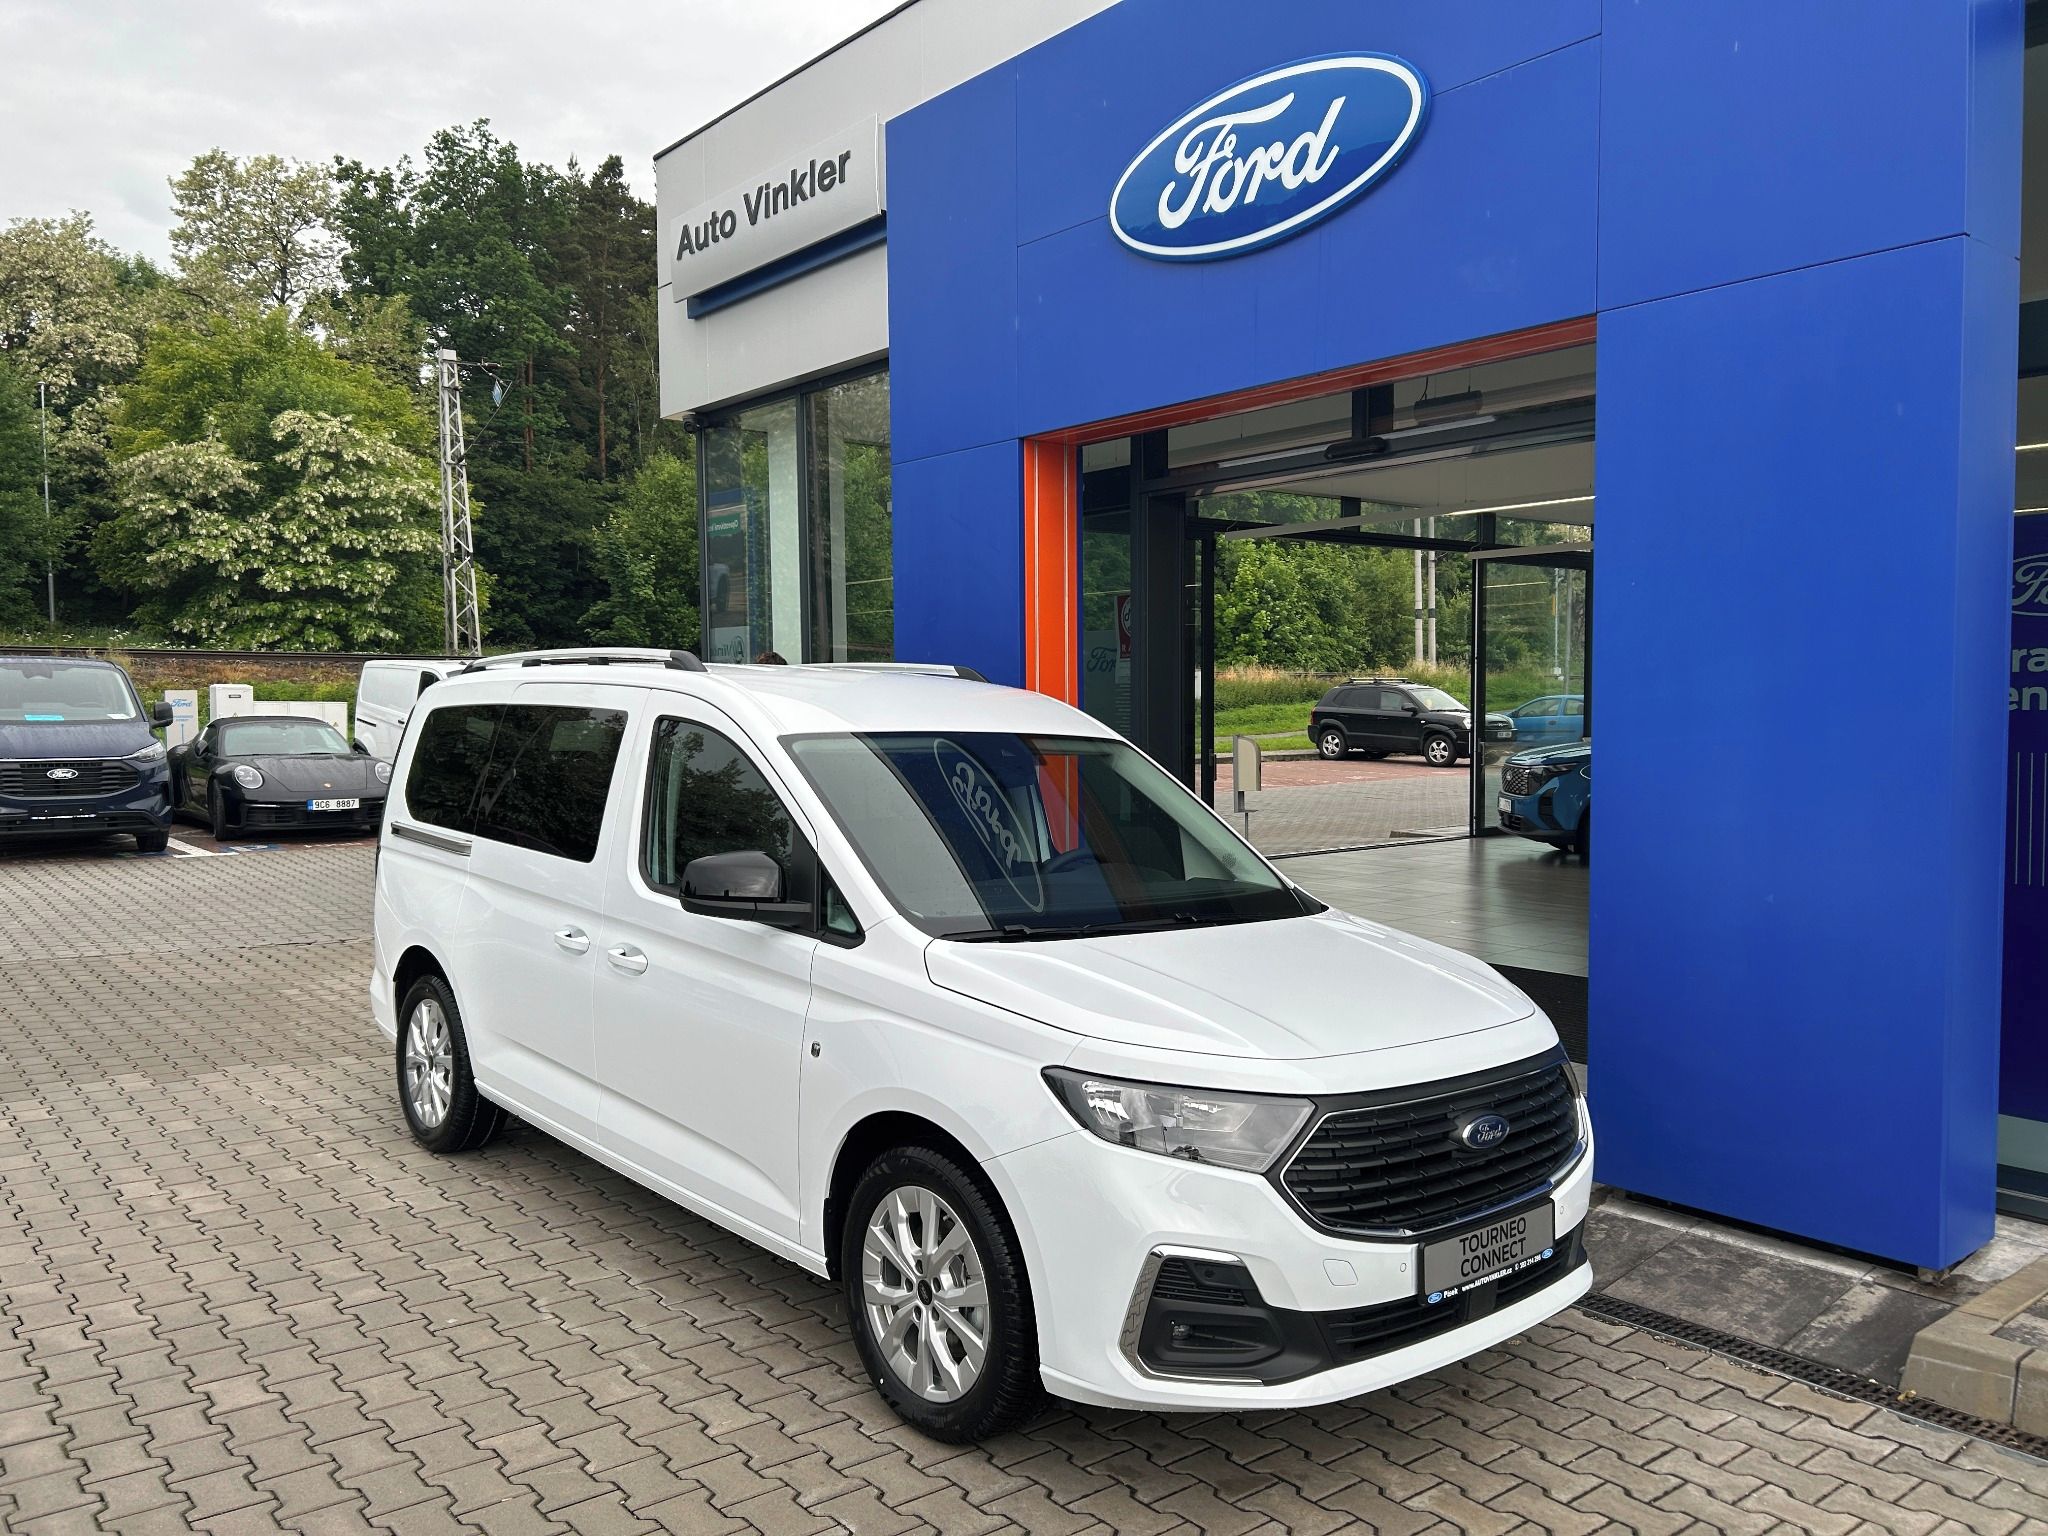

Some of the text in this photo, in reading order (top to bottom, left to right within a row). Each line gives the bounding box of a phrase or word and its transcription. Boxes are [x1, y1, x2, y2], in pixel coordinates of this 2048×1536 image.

[1158, 92, 1346, 229] Ford
[676, 149, 851, 262] Auto Vinkler
[336, 800, 356, 808] 8887
[1477, 1122, 1503, 1142] Ford
[1459, 1217, 1526, 1256] TOURNEO
[1461, 1237, 1526, 1277] CONNECT
